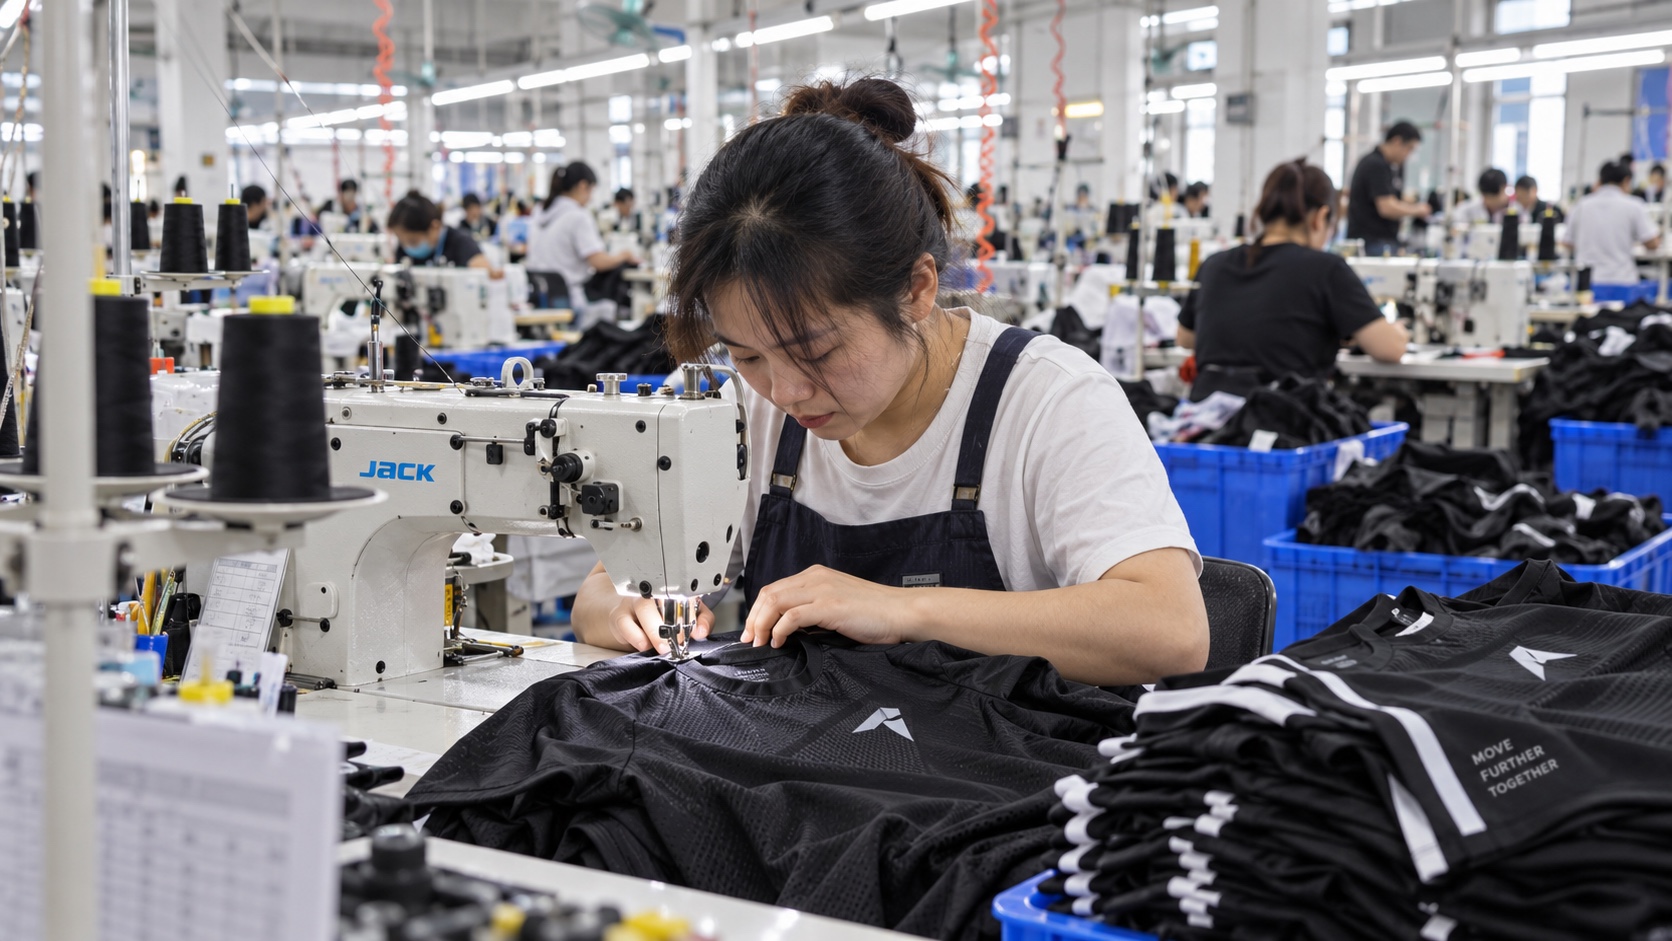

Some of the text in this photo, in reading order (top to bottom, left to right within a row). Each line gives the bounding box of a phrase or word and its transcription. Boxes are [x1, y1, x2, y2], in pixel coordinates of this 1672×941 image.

[1471, 738, 1514, 766] MOVE
[1479, 745, 1545, 782] FURTHER
[1487, 758, 1559, 797] TOGETHER
